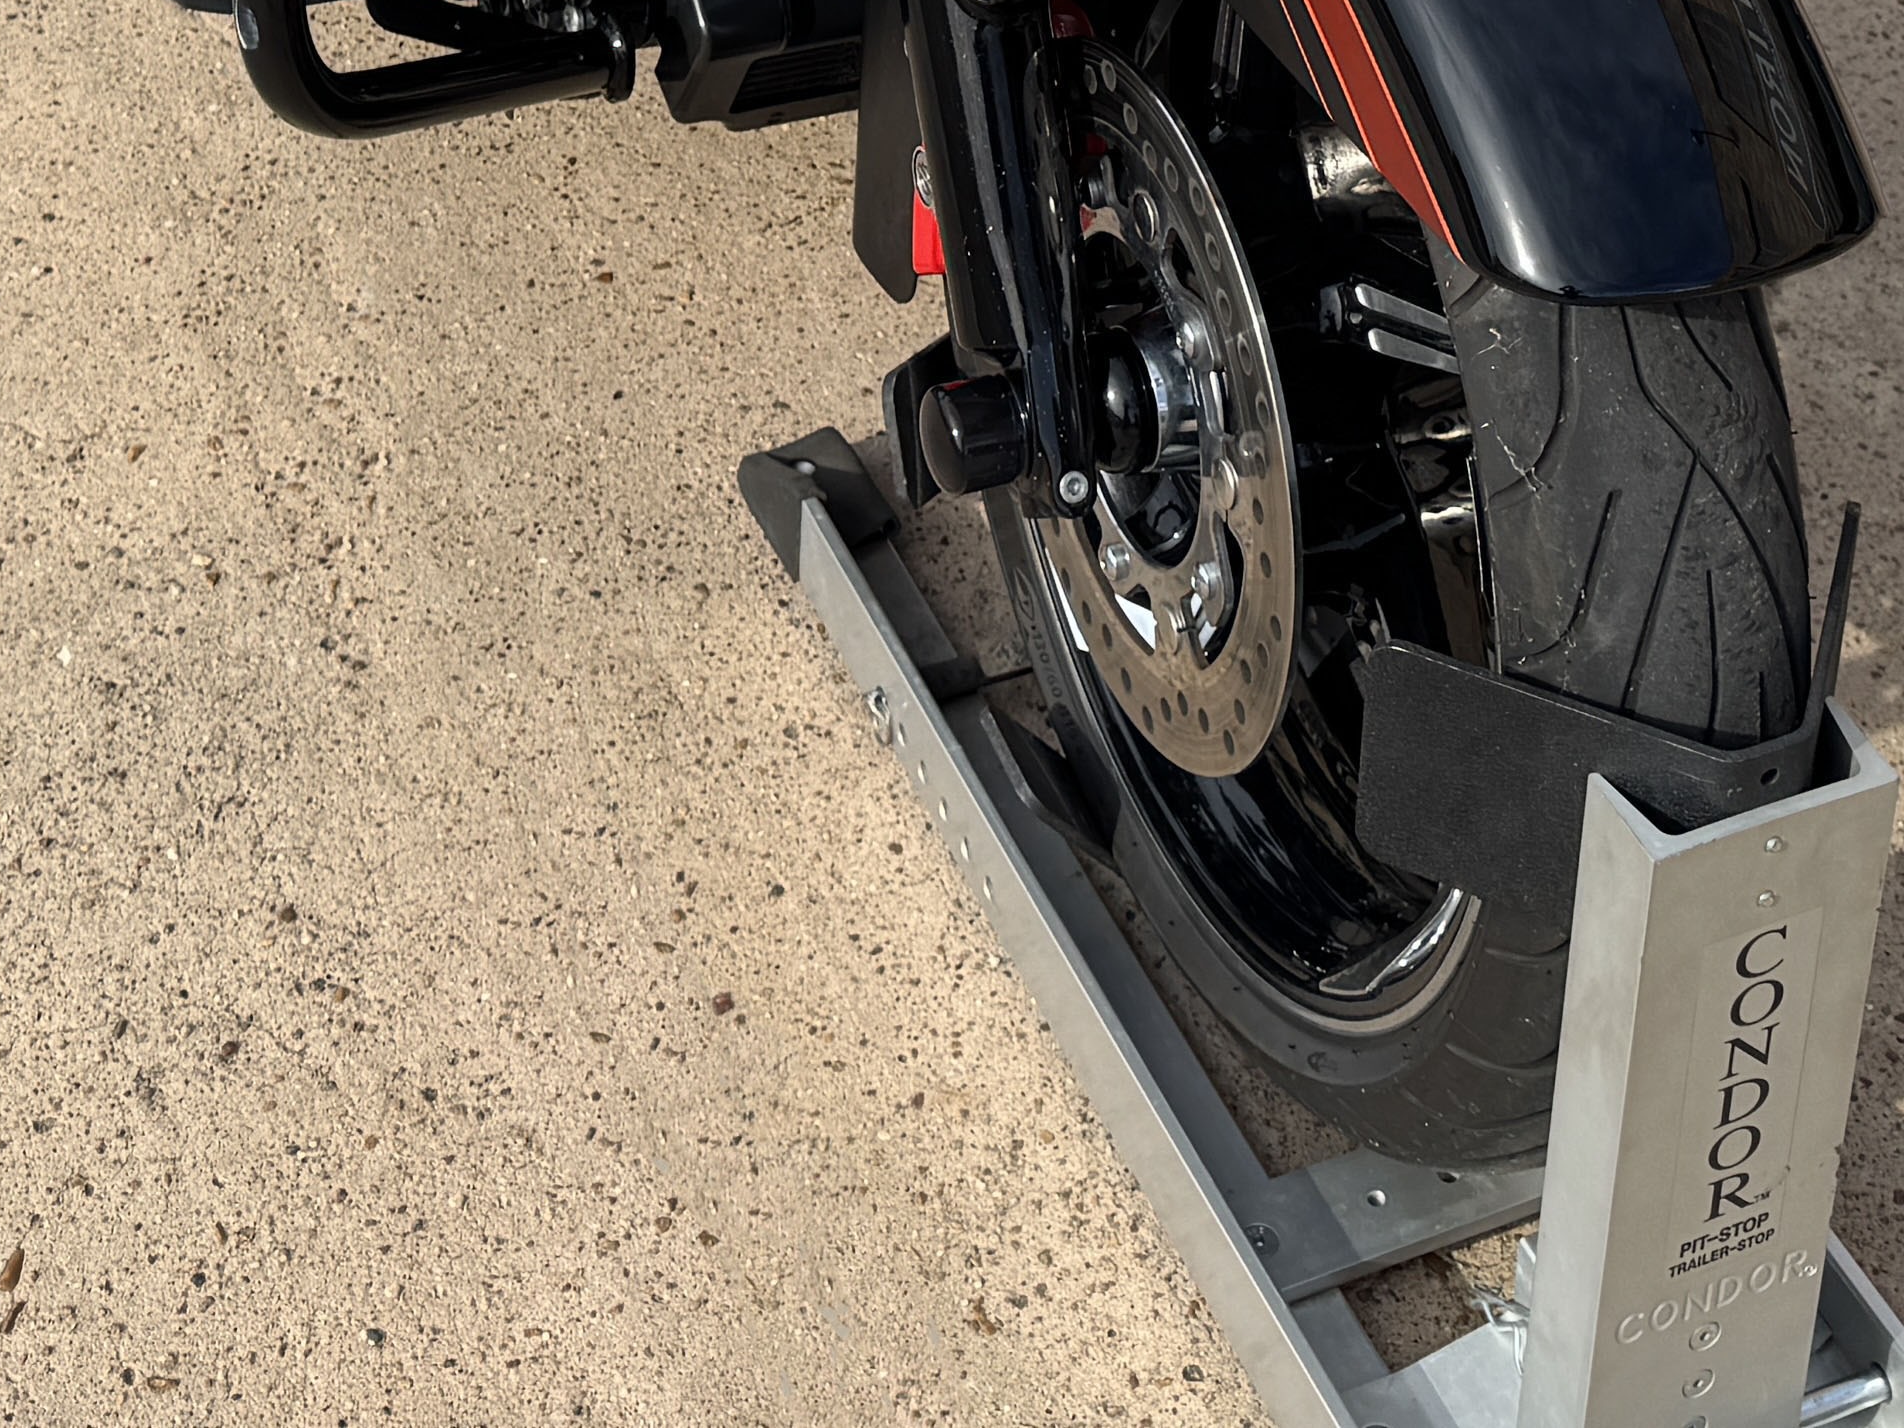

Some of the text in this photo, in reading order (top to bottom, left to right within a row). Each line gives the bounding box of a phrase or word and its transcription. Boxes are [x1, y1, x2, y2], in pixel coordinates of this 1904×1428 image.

[1704, 925, 1788, 1223] CONDOR
[1668, 1228, 1776, 1278] TRAILER-STOP
[1680, 1211, 1770, 1259] PIT-STOP
[1616, 1248, 1808, 1344] CONDOR
